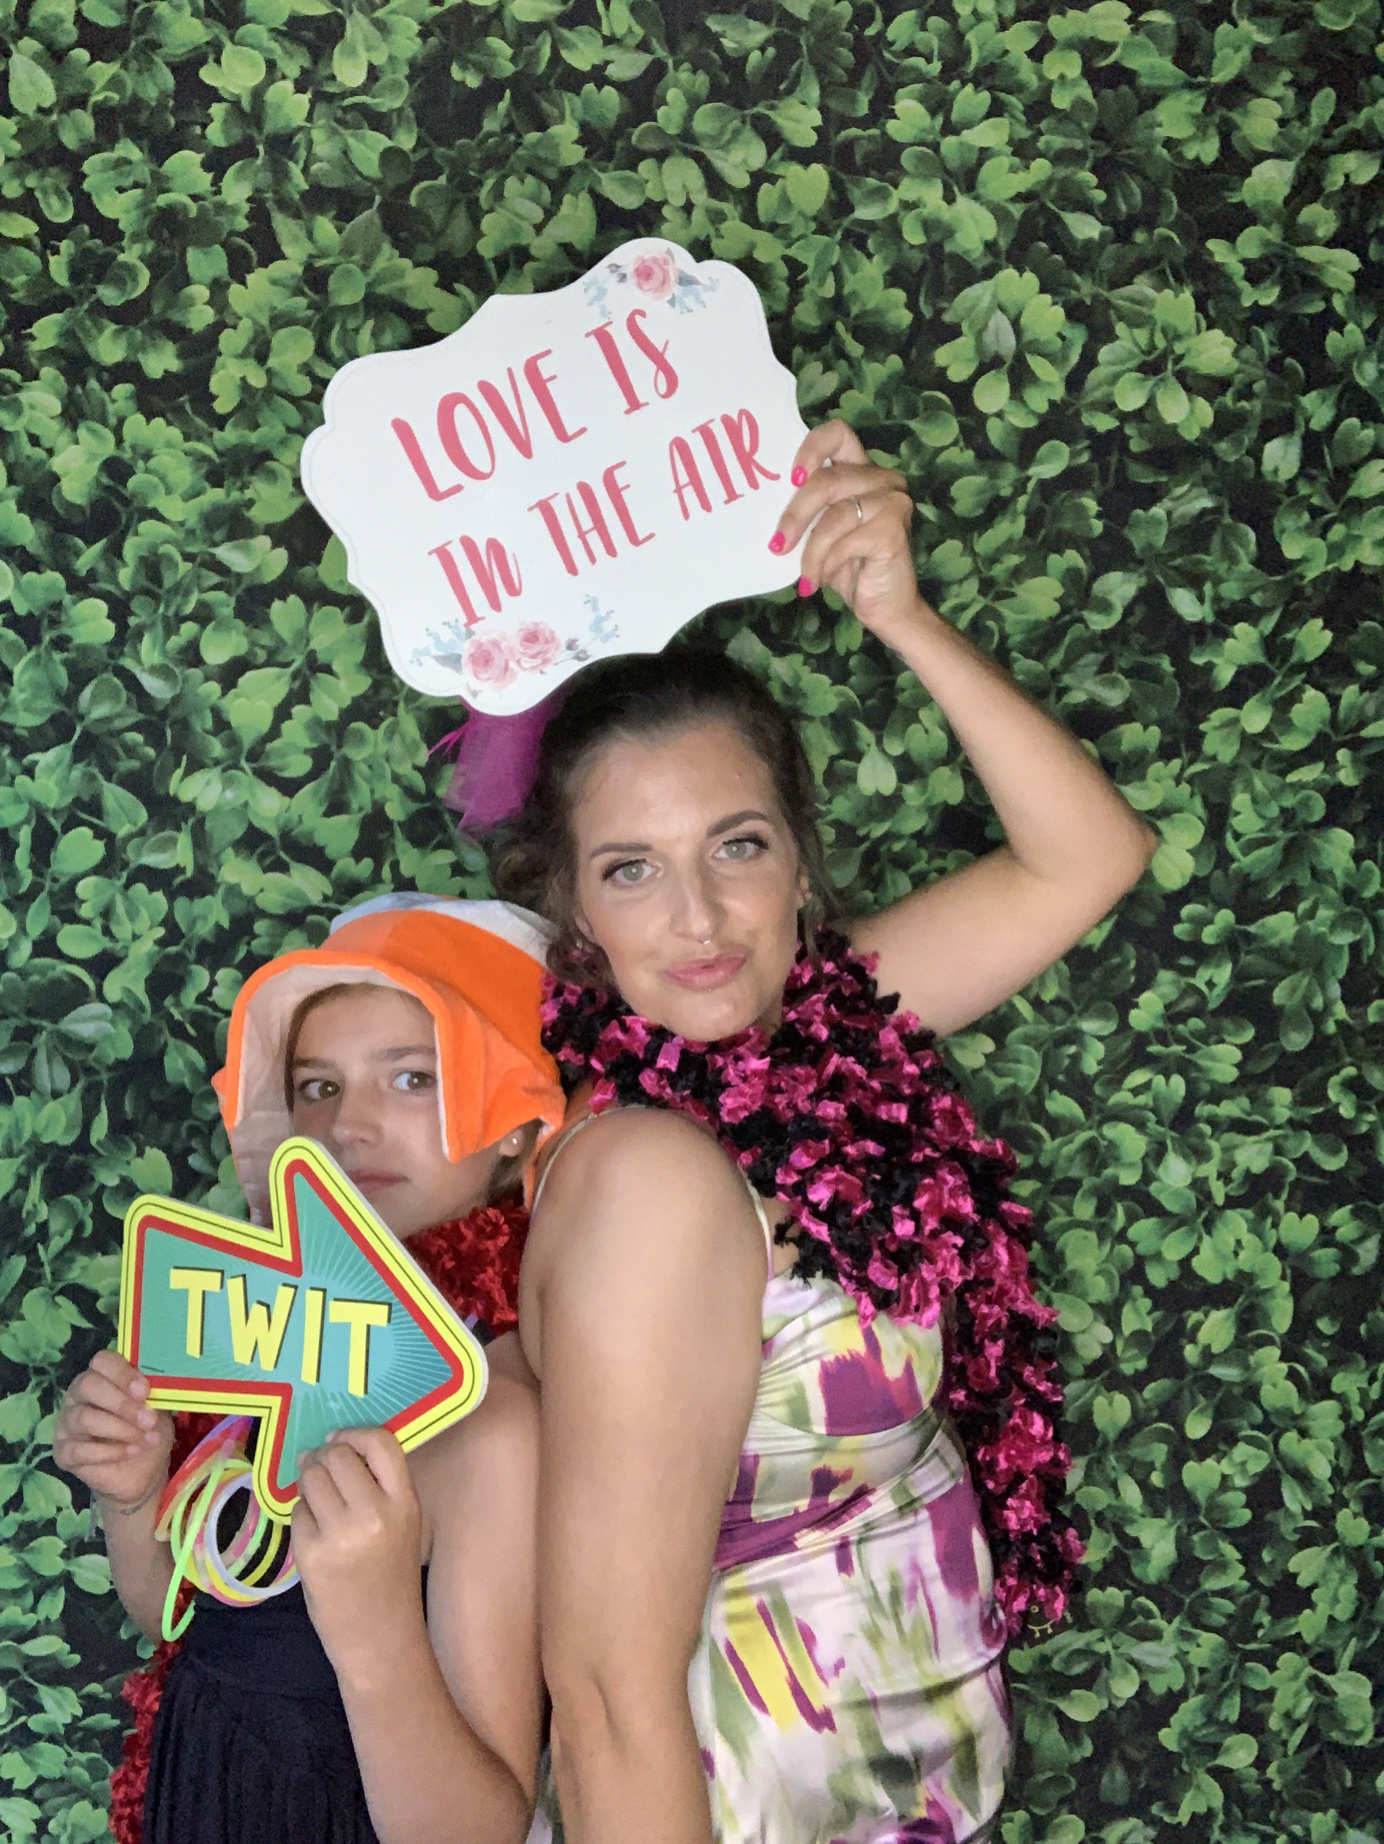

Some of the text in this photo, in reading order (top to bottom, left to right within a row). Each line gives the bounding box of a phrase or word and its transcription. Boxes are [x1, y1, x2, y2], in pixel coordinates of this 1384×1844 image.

[391, 308, 679, 502] LOVE IS
[427, 408, 781, 627] IN THE AIR
[169, 1265, 393, 1398] TWIT
